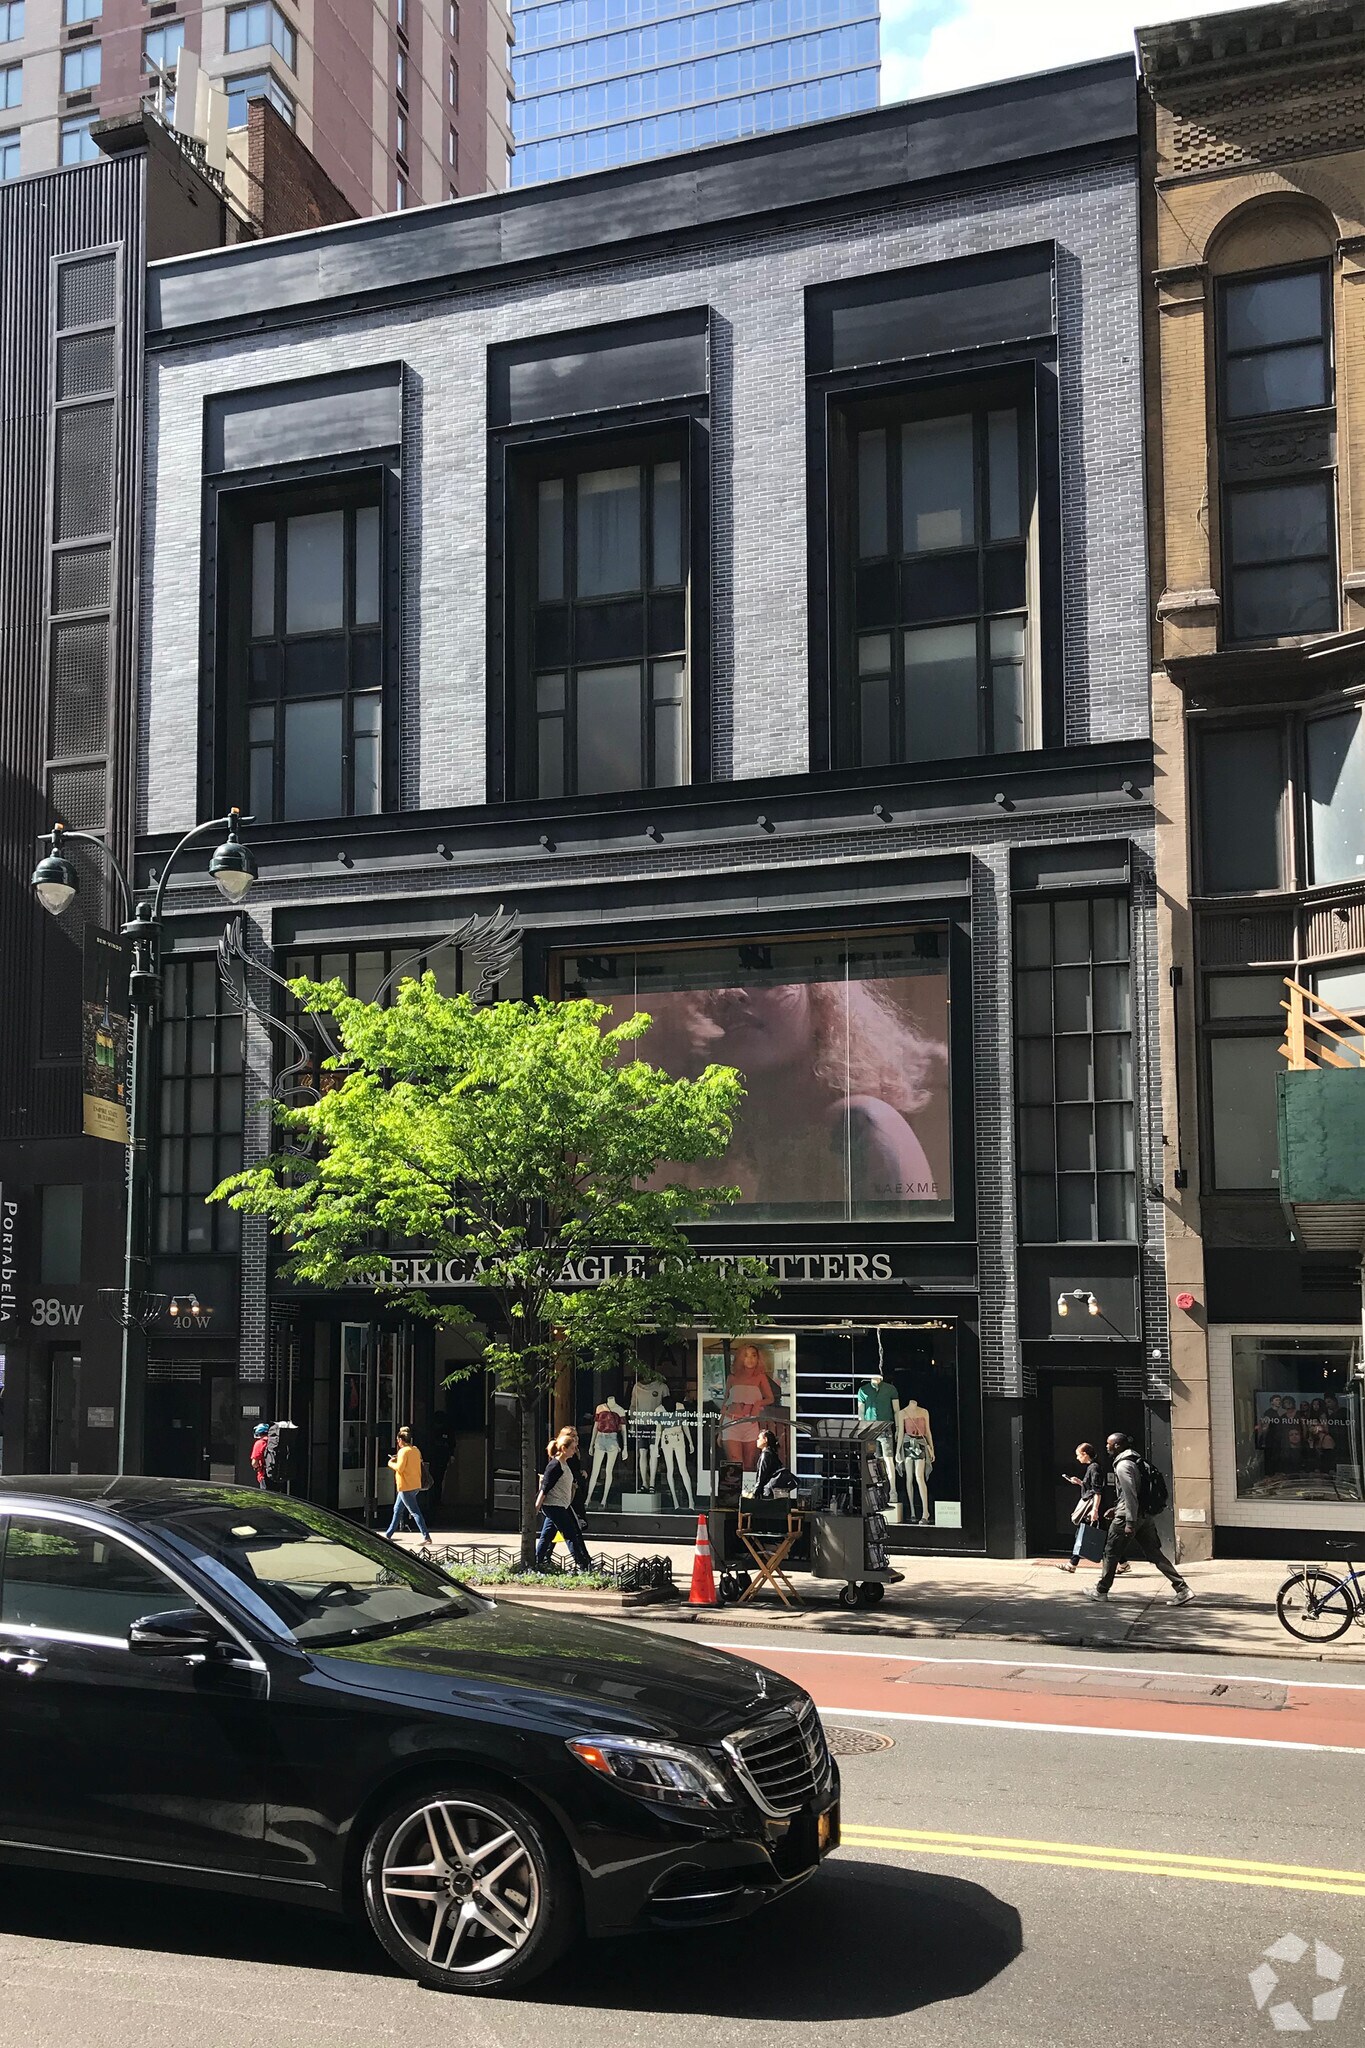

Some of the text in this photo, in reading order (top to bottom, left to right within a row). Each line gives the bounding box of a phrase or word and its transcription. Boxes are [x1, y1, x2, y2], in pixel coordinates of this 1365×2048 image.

[173, 1316, 211, 1329] 40 W
[675, 1410, 722, 1420] individuality
[660, 1419, 676, 1427] way
[1282, 1417, 1299, 1425] RUN
